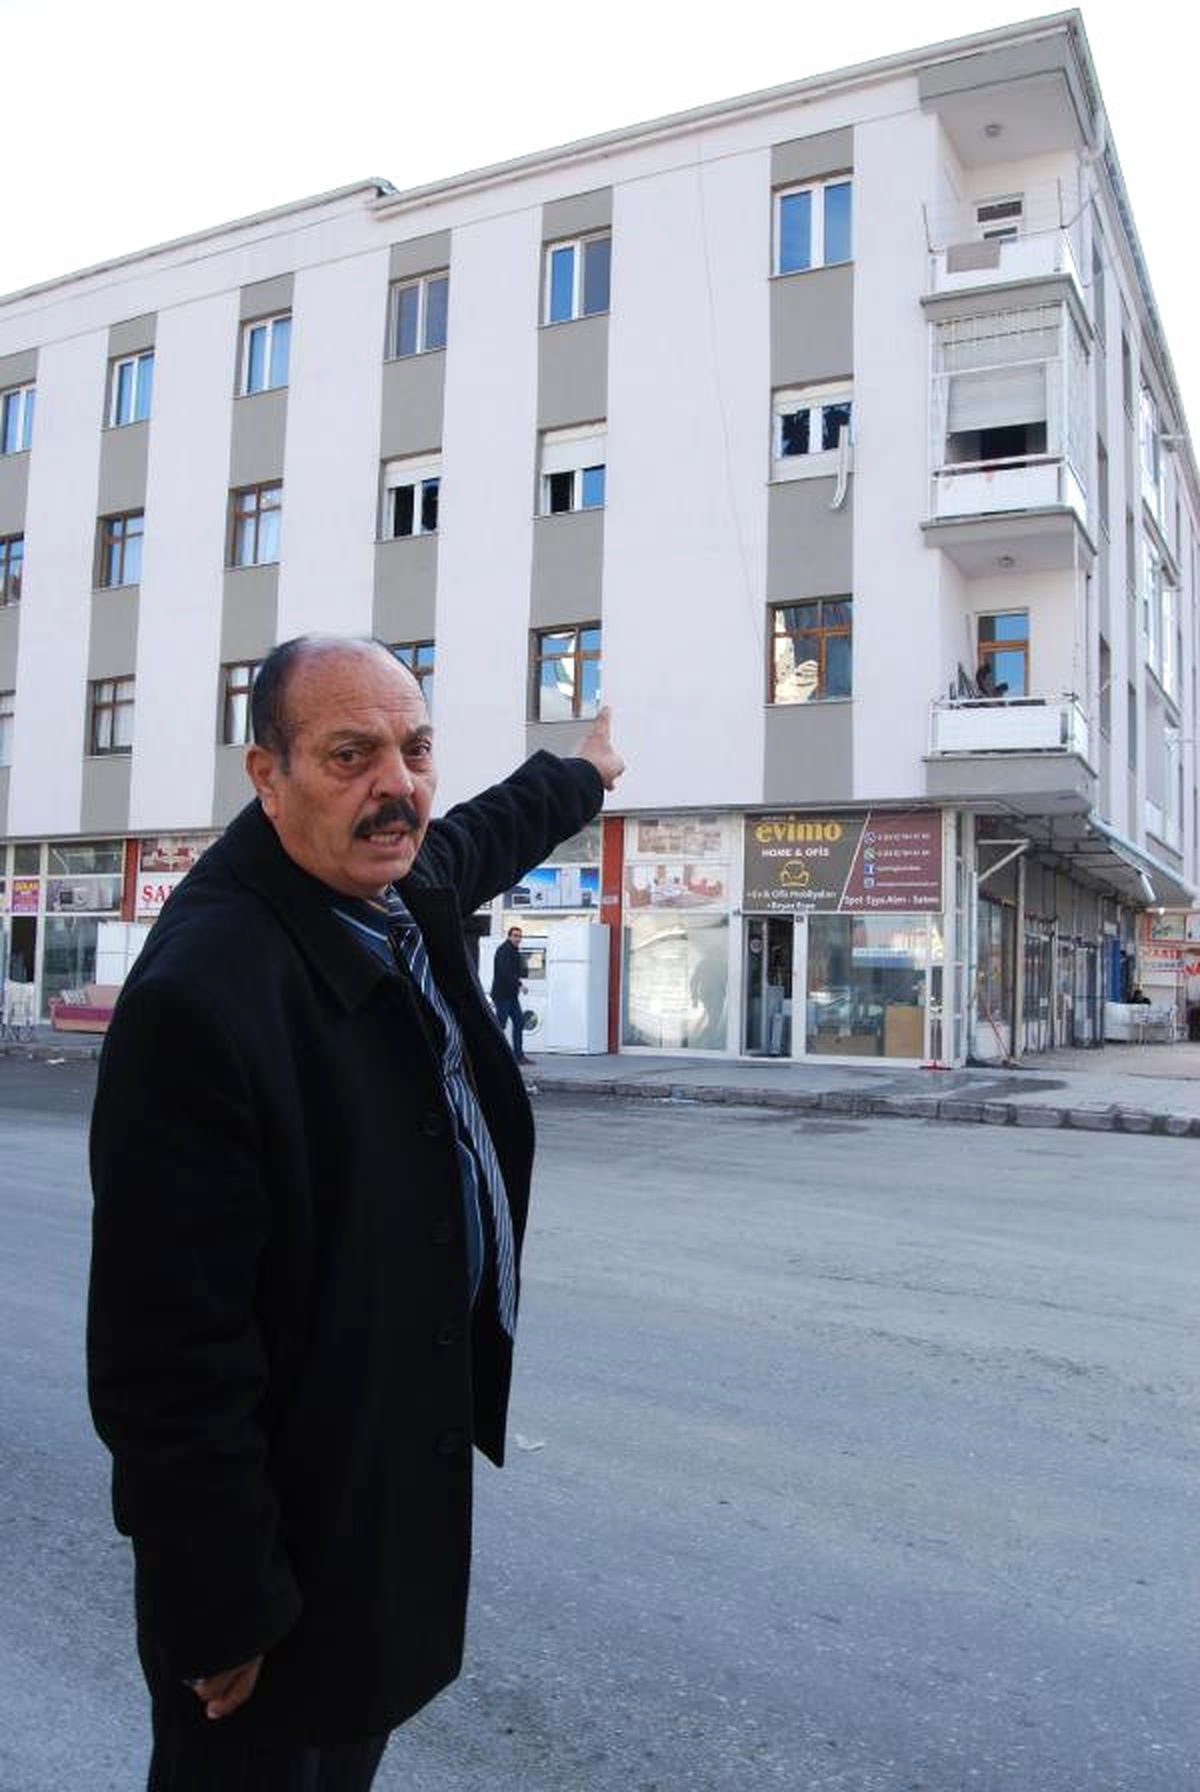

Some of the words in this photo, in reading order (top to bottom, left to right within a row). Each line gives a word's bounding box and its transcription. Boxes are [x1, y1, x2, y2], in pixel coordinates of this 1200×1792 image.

[755, 821, 843, 844] evimo
[761, 847, 793, 857] HOME
[794, 847, 803, 857] &
